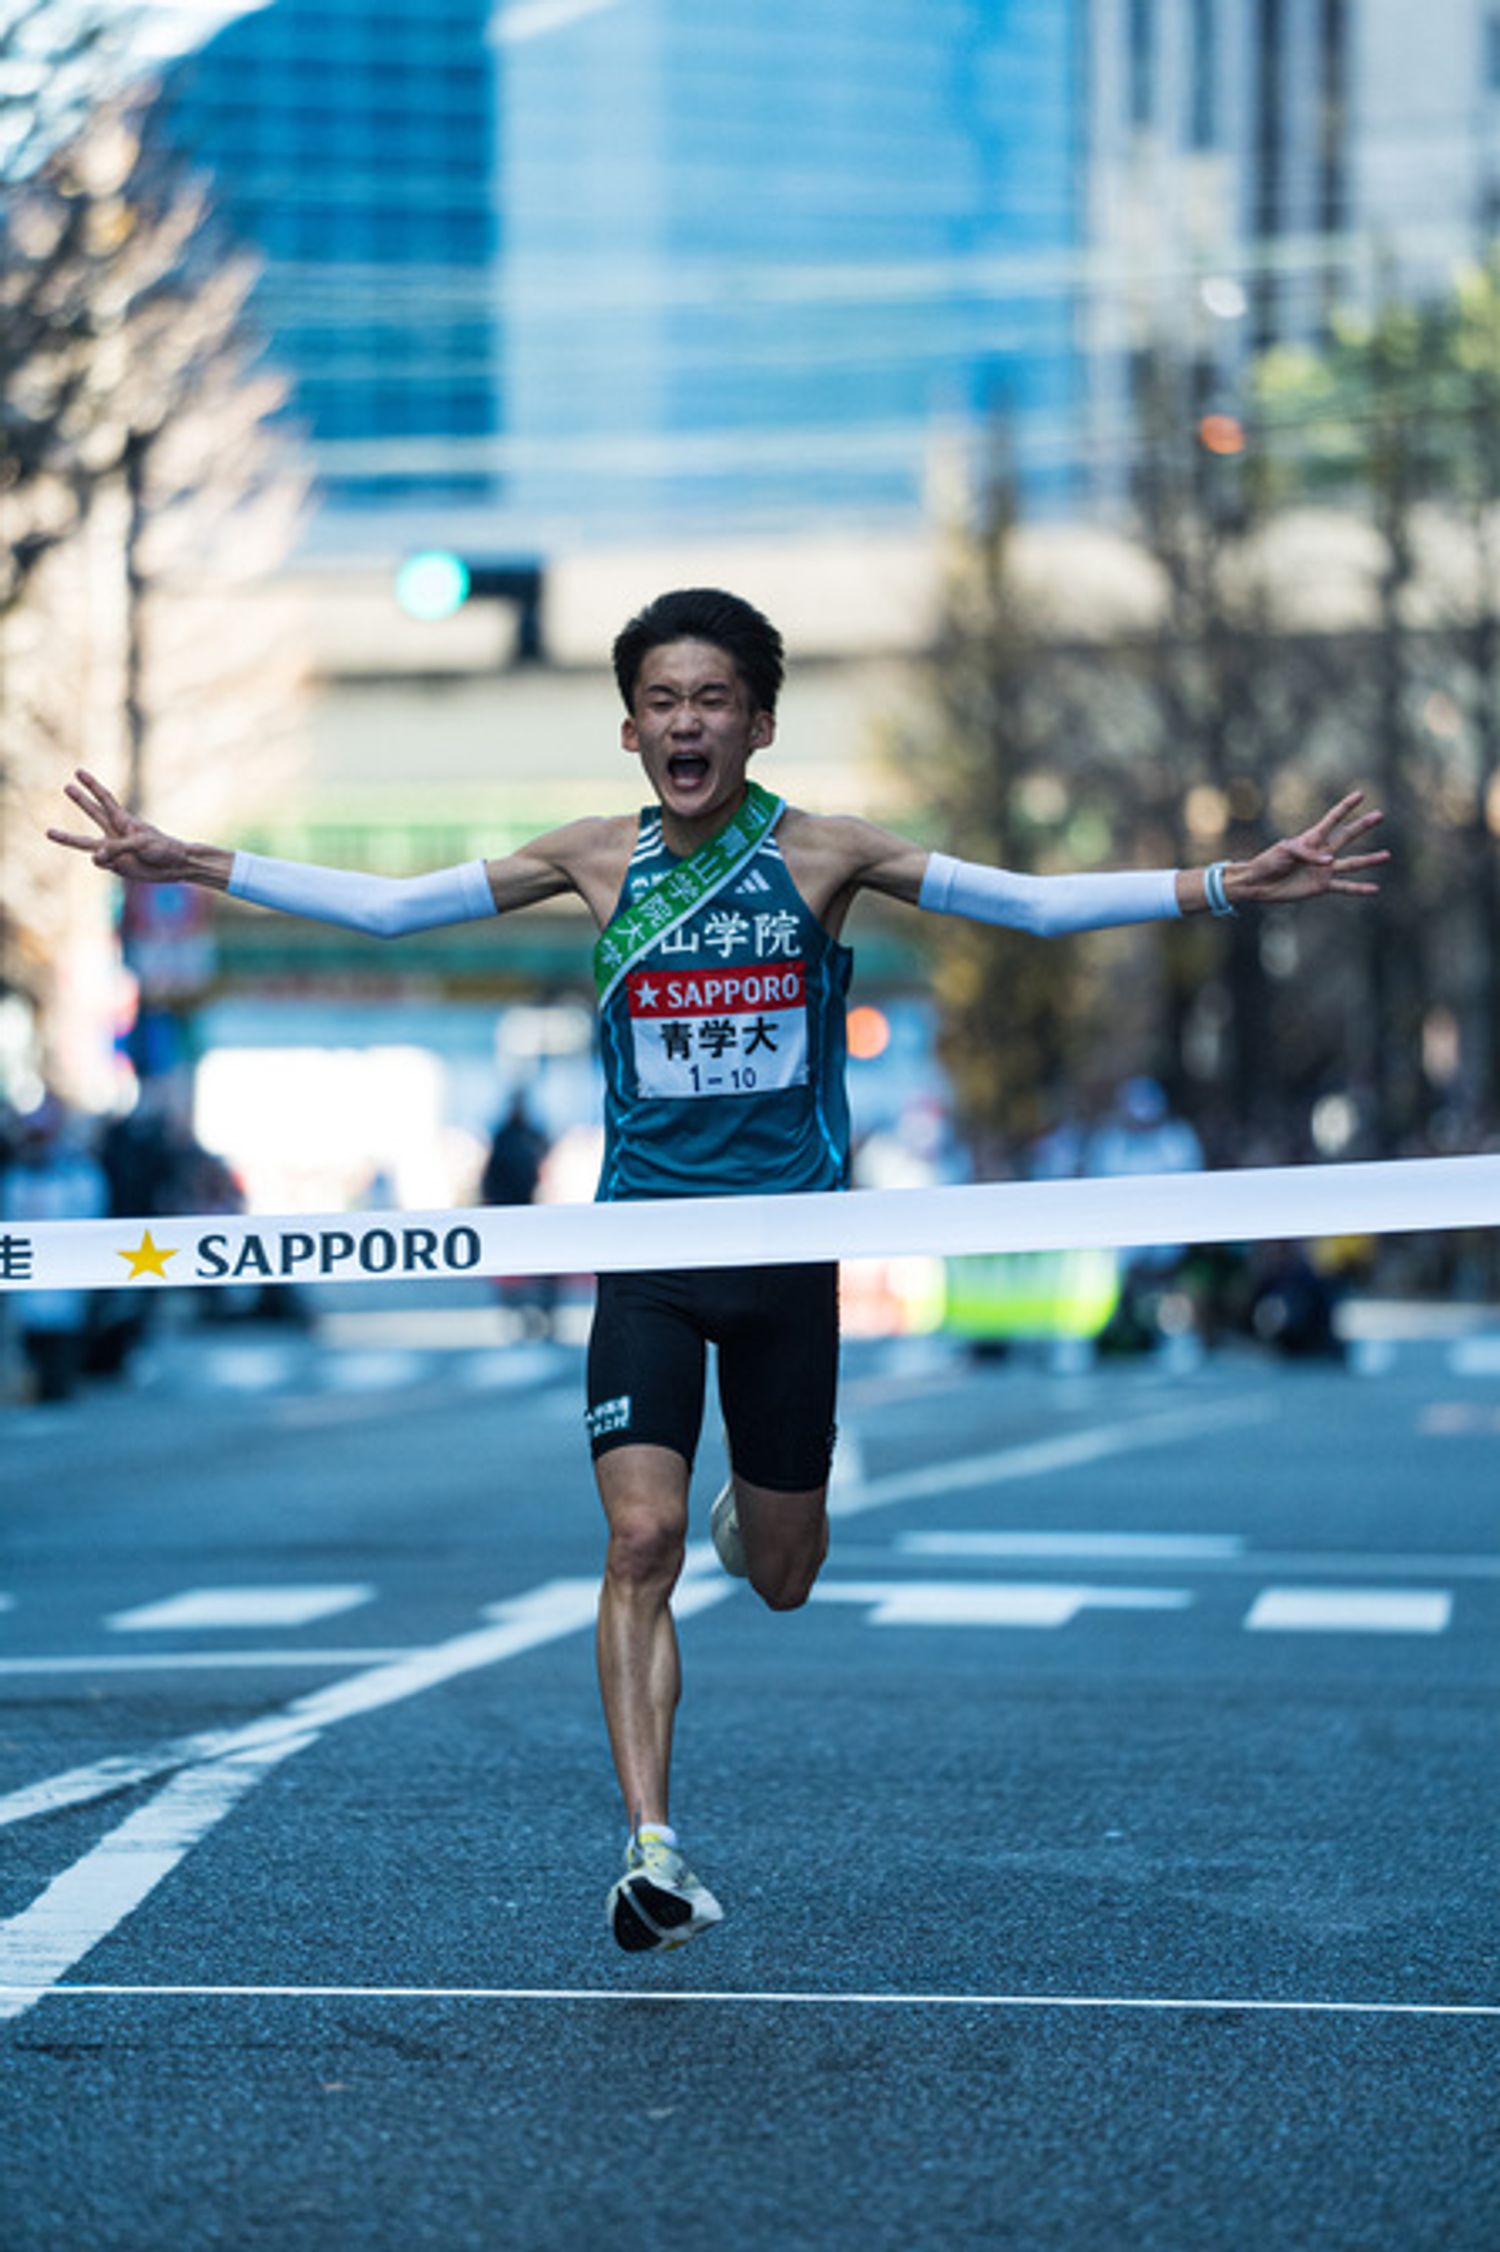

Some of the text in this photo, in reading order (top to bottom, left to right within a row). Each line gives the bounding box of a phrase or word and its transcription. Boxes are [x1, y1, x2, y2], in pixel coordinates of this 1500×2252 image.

[642, 910, 802, 958] 山学院
[667, 973, 799, 1009] SAPPORO
[661, 1016, 779, 1060] 青学大
[196, 1226, 482, 1279] SAPPORO
